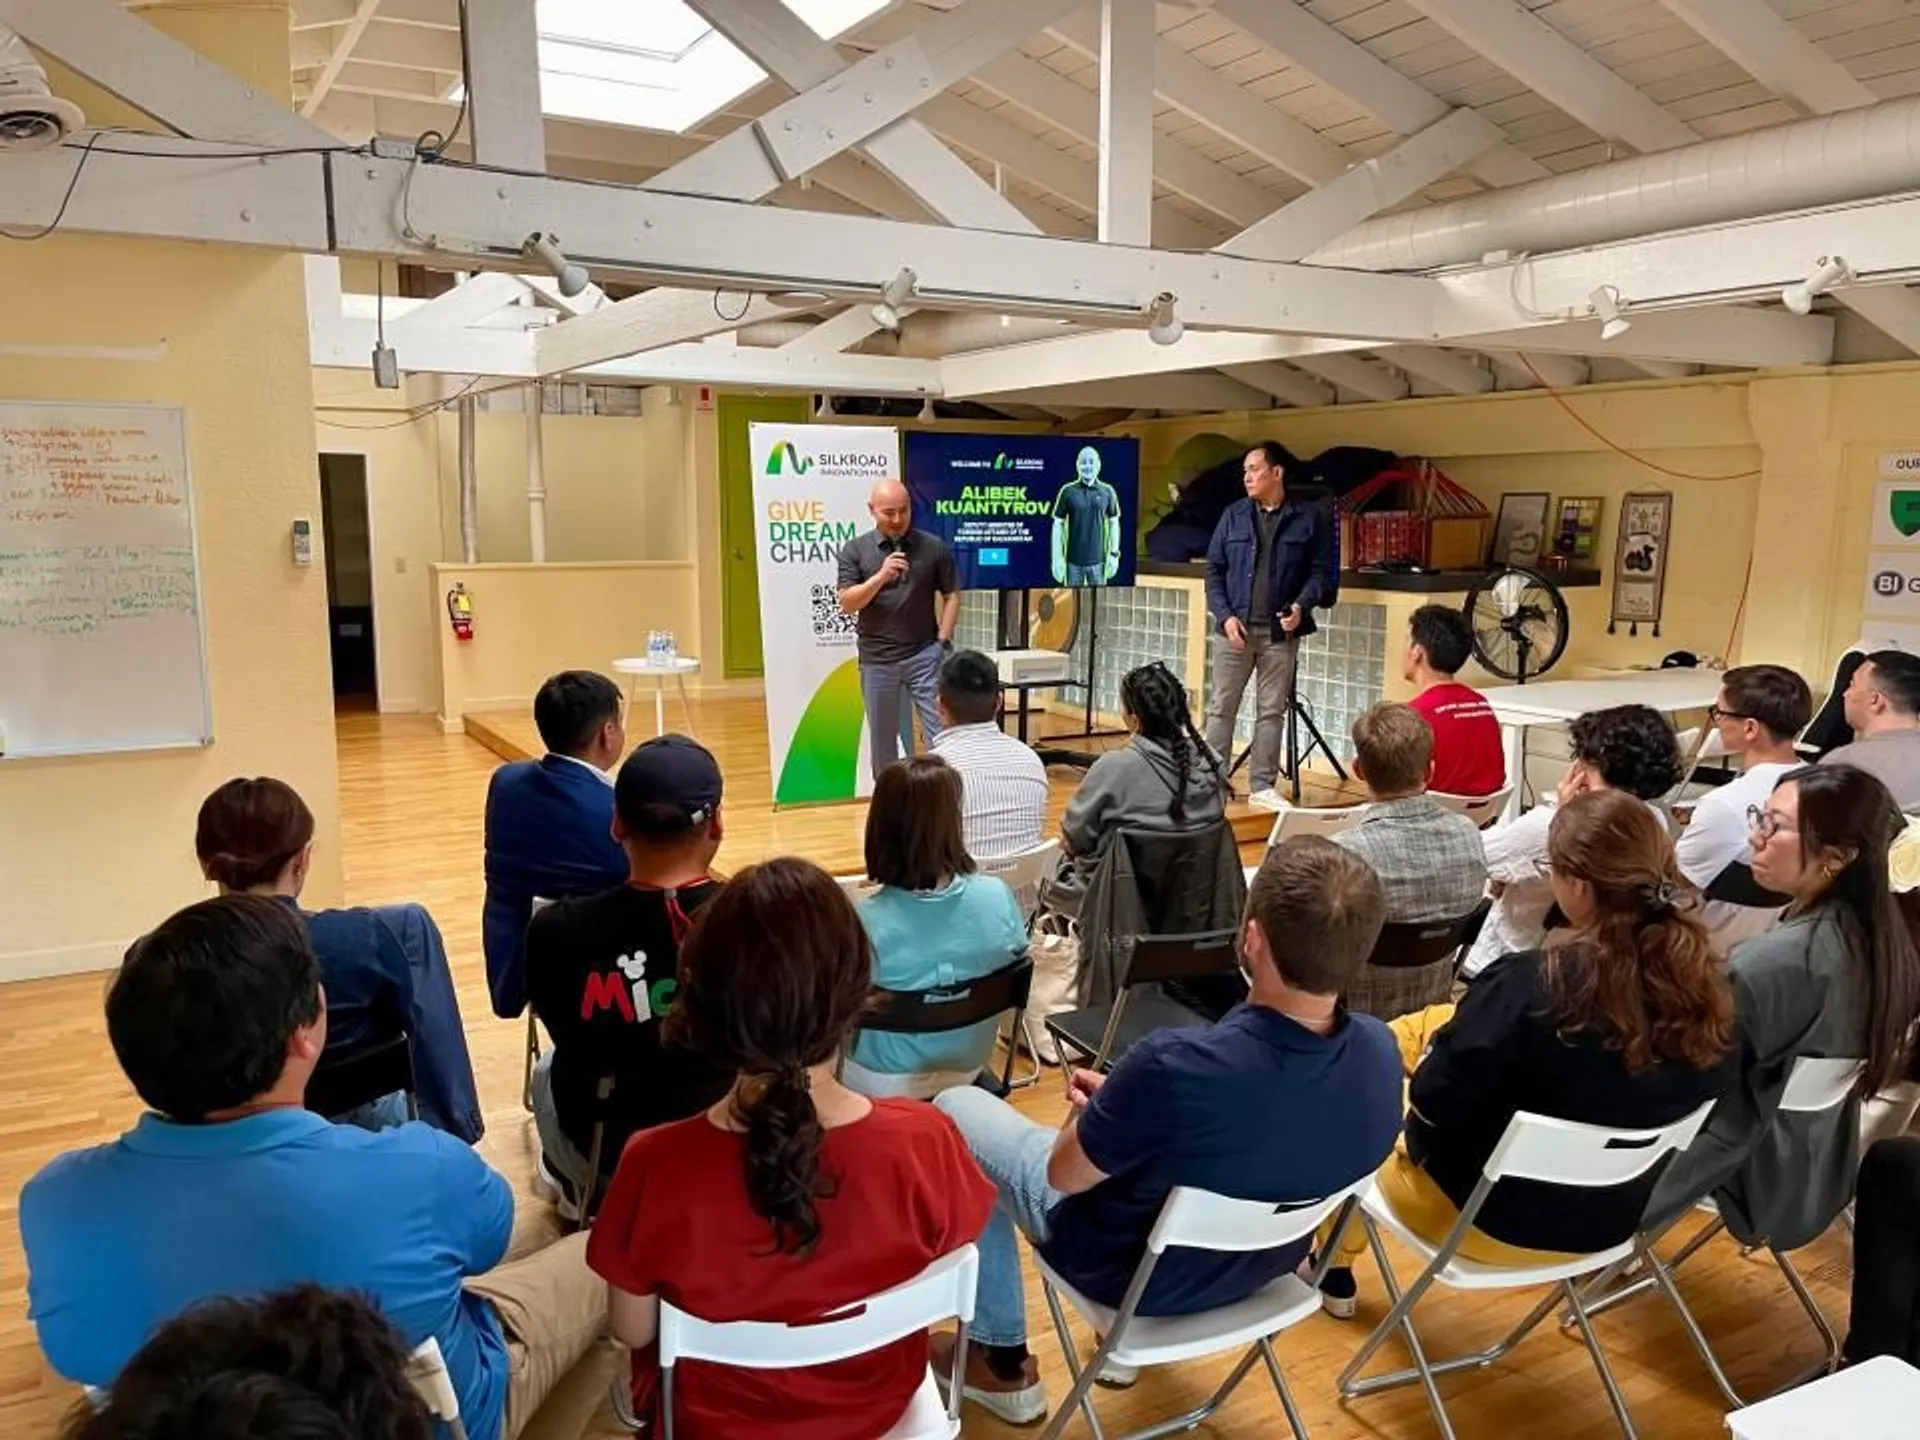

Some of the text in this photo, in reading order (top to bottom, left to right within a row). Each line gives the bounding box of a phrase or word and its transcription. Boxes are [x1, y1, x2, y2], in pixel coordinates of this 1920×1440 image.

[819, 453, 887, 467] SILKROAD
[961, 486, 1027, 500] ALIBEK
[768, 501, 825, 520] GIVE
[936, 500, 1051, 515] KUANTYROV
[769, 521, 855, 541] DREAM
[1878, 574, 1900, 593] BI
